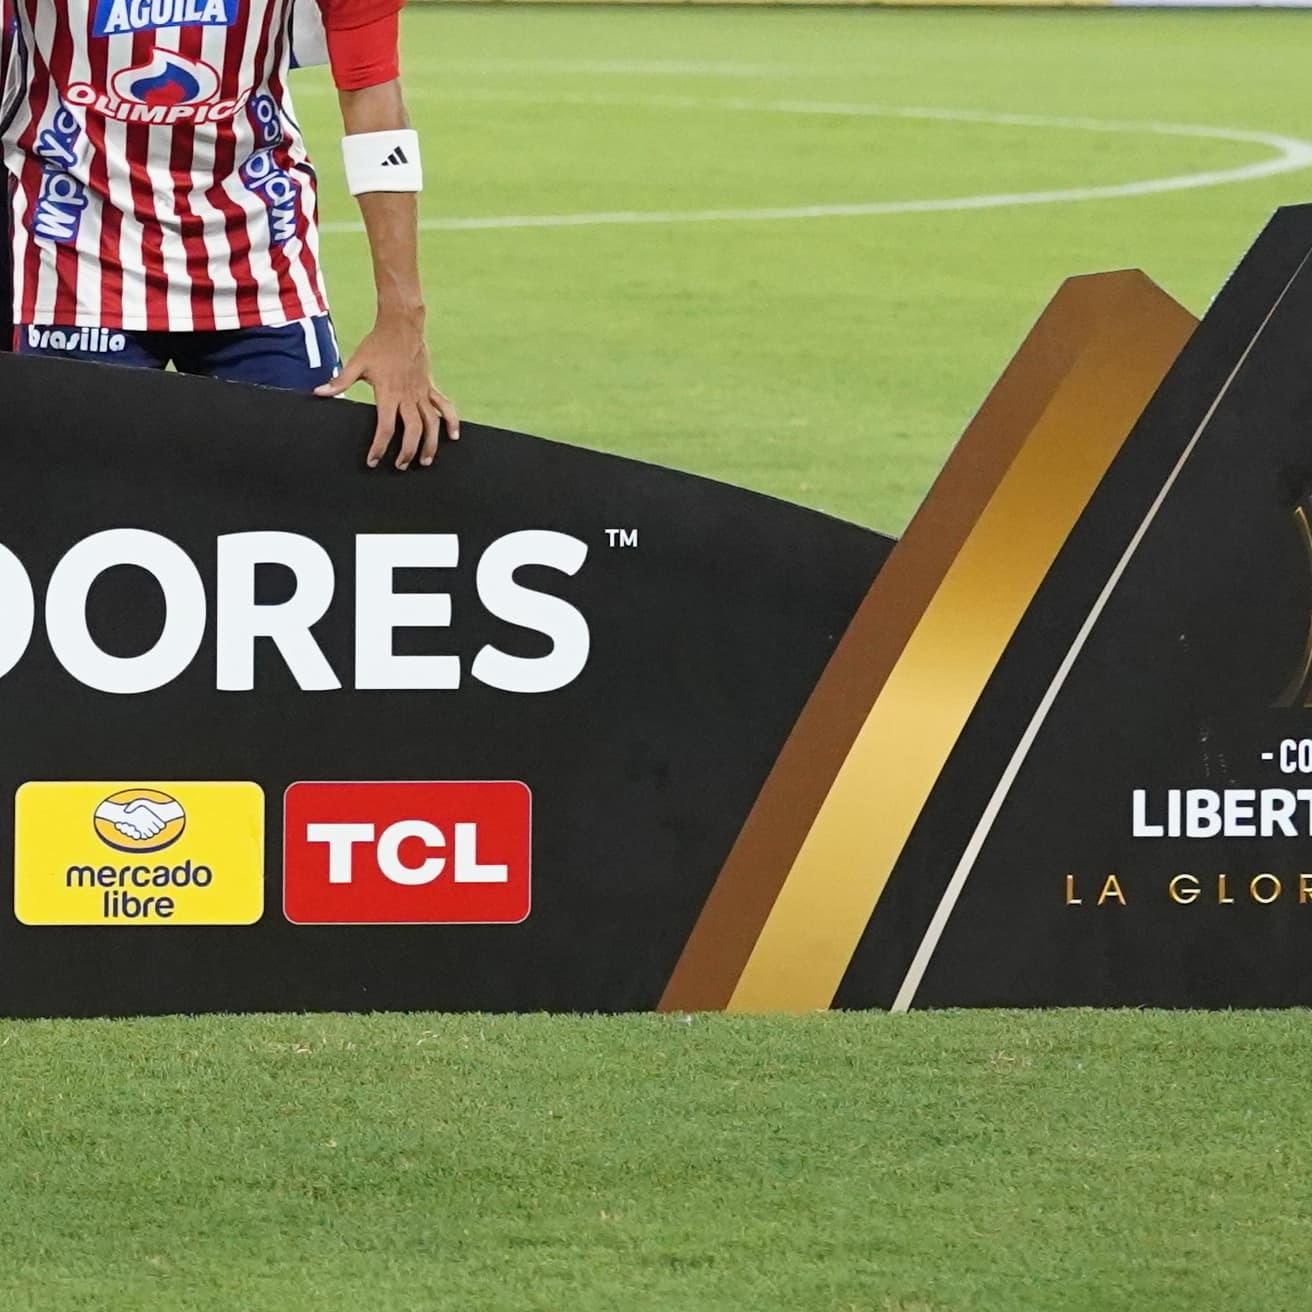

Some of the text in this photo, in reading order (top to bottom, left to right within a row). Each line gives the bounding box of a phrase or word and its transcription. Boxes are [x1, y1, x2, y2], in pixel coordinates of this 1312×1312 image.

[27, 326, 126, 353] brasilia
[306, 819, 508, 886] TCL
[66, 859, 213, 888] mercado
[1065, 873, 1127, 906] LA
[103, 891, 175, 919] libre
